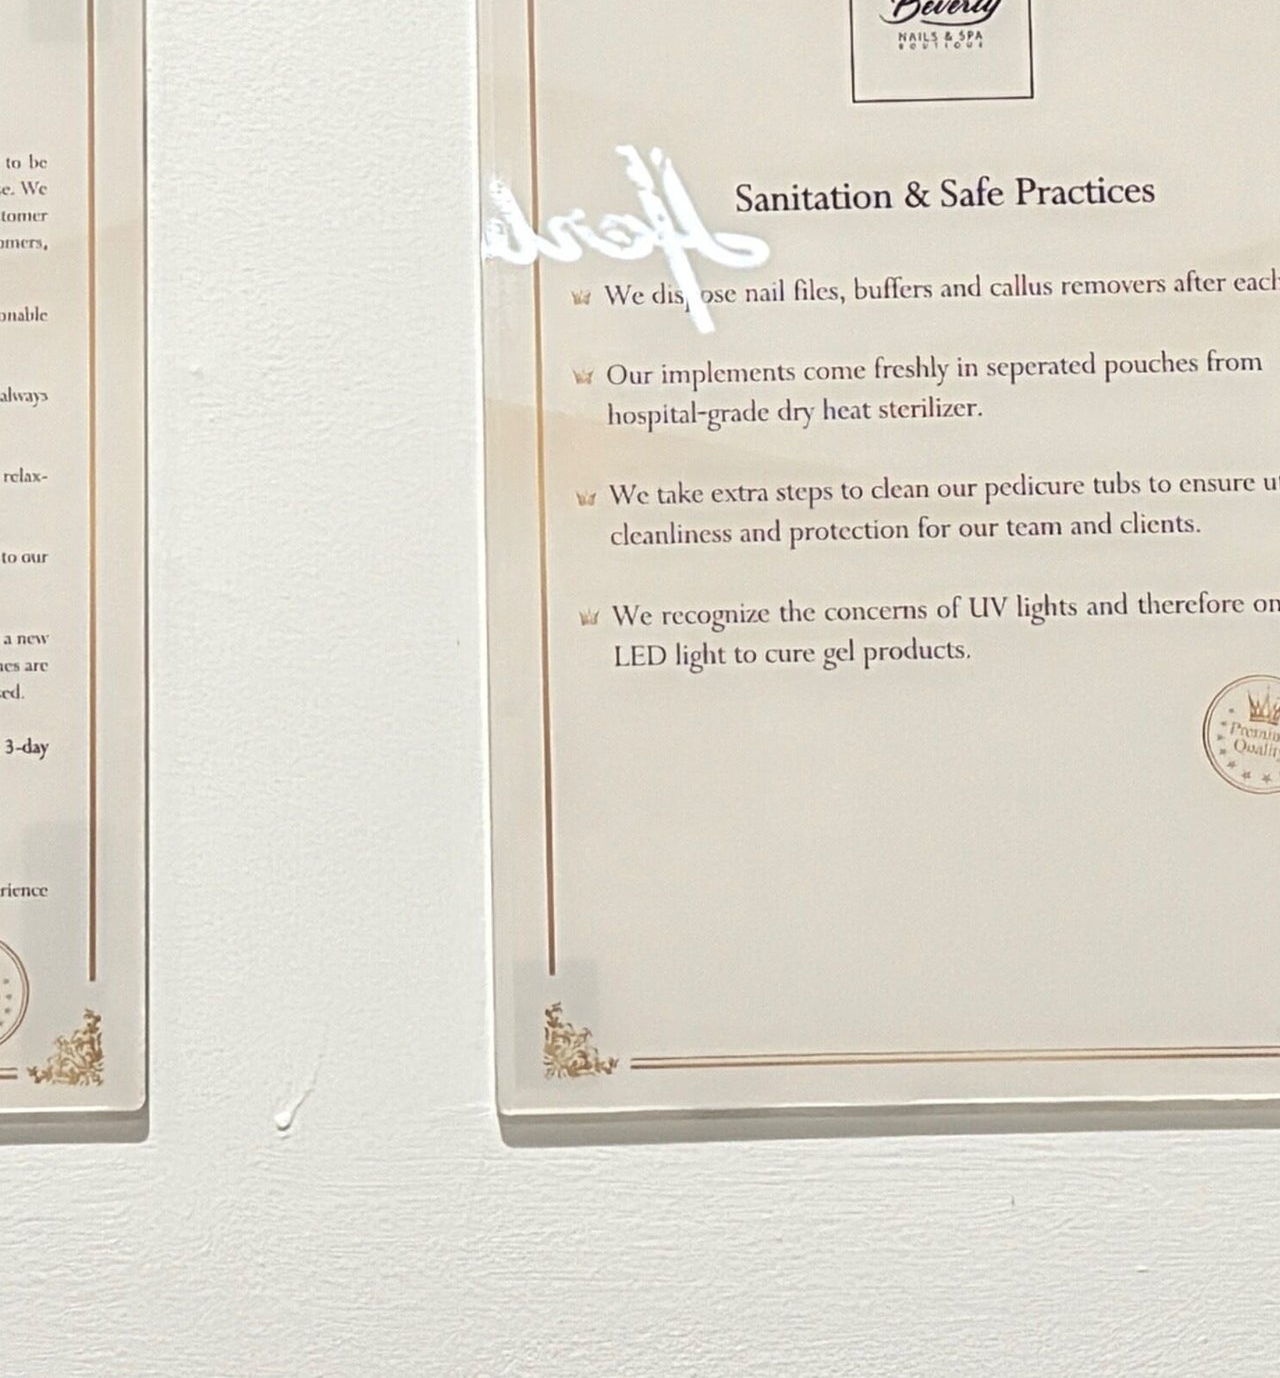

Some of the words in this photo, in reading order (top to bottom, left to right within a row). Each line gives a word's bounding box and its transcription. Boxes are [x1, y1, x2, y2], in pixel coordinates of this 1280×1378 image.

[898, 31, 938, 42] NAILS
[944, 31, 953, 42] &
[958, 30, 983, 41] SPA
[735, 181, 894, 213] Sanitation
[904, 179, 932, 210] &
[940, 174, 1005, 209] Safe
[1014, 175, 1156, 207] Practices
[603, 283, 645, 307] We
[651, 281, 737, 313] disose
[744, 277, 785, 303] nail
[794, 277, 846, 306] files,
[853, 274, 933, 301] buffers
[940, 272, 982, 299] and
[989, 272, 1054, 298] callus
[1061, 277, 1167, 297] removers
[1173, 268, 1227, 294] after
[606, 362, 654, 386] Our
[661, 358, 796, 394] implements
[803, 364, 867, 382] come
[874, 354, 950, 388] freshly
[956, 355, 979, 379] in
[986, 349, 1097, 387] seperated
[1104, 349, 1199, 385] pouches
[1206, 348, 1264, 373] from
[607, 397, 770, 435] hospital-grade
[777, 397, 816, 431] dry
[822, 396, 872, 422] heat
[878, 394, 983, 420] sterilizer.
[614, 643, 668, 668] LED
[675, 640, 727, 675] light
[733, 646, 758, 665] to
[764, 647, 816, 664] cure
[822, 636, 855, 673] gel
[863, 634, 971, 671] products.
